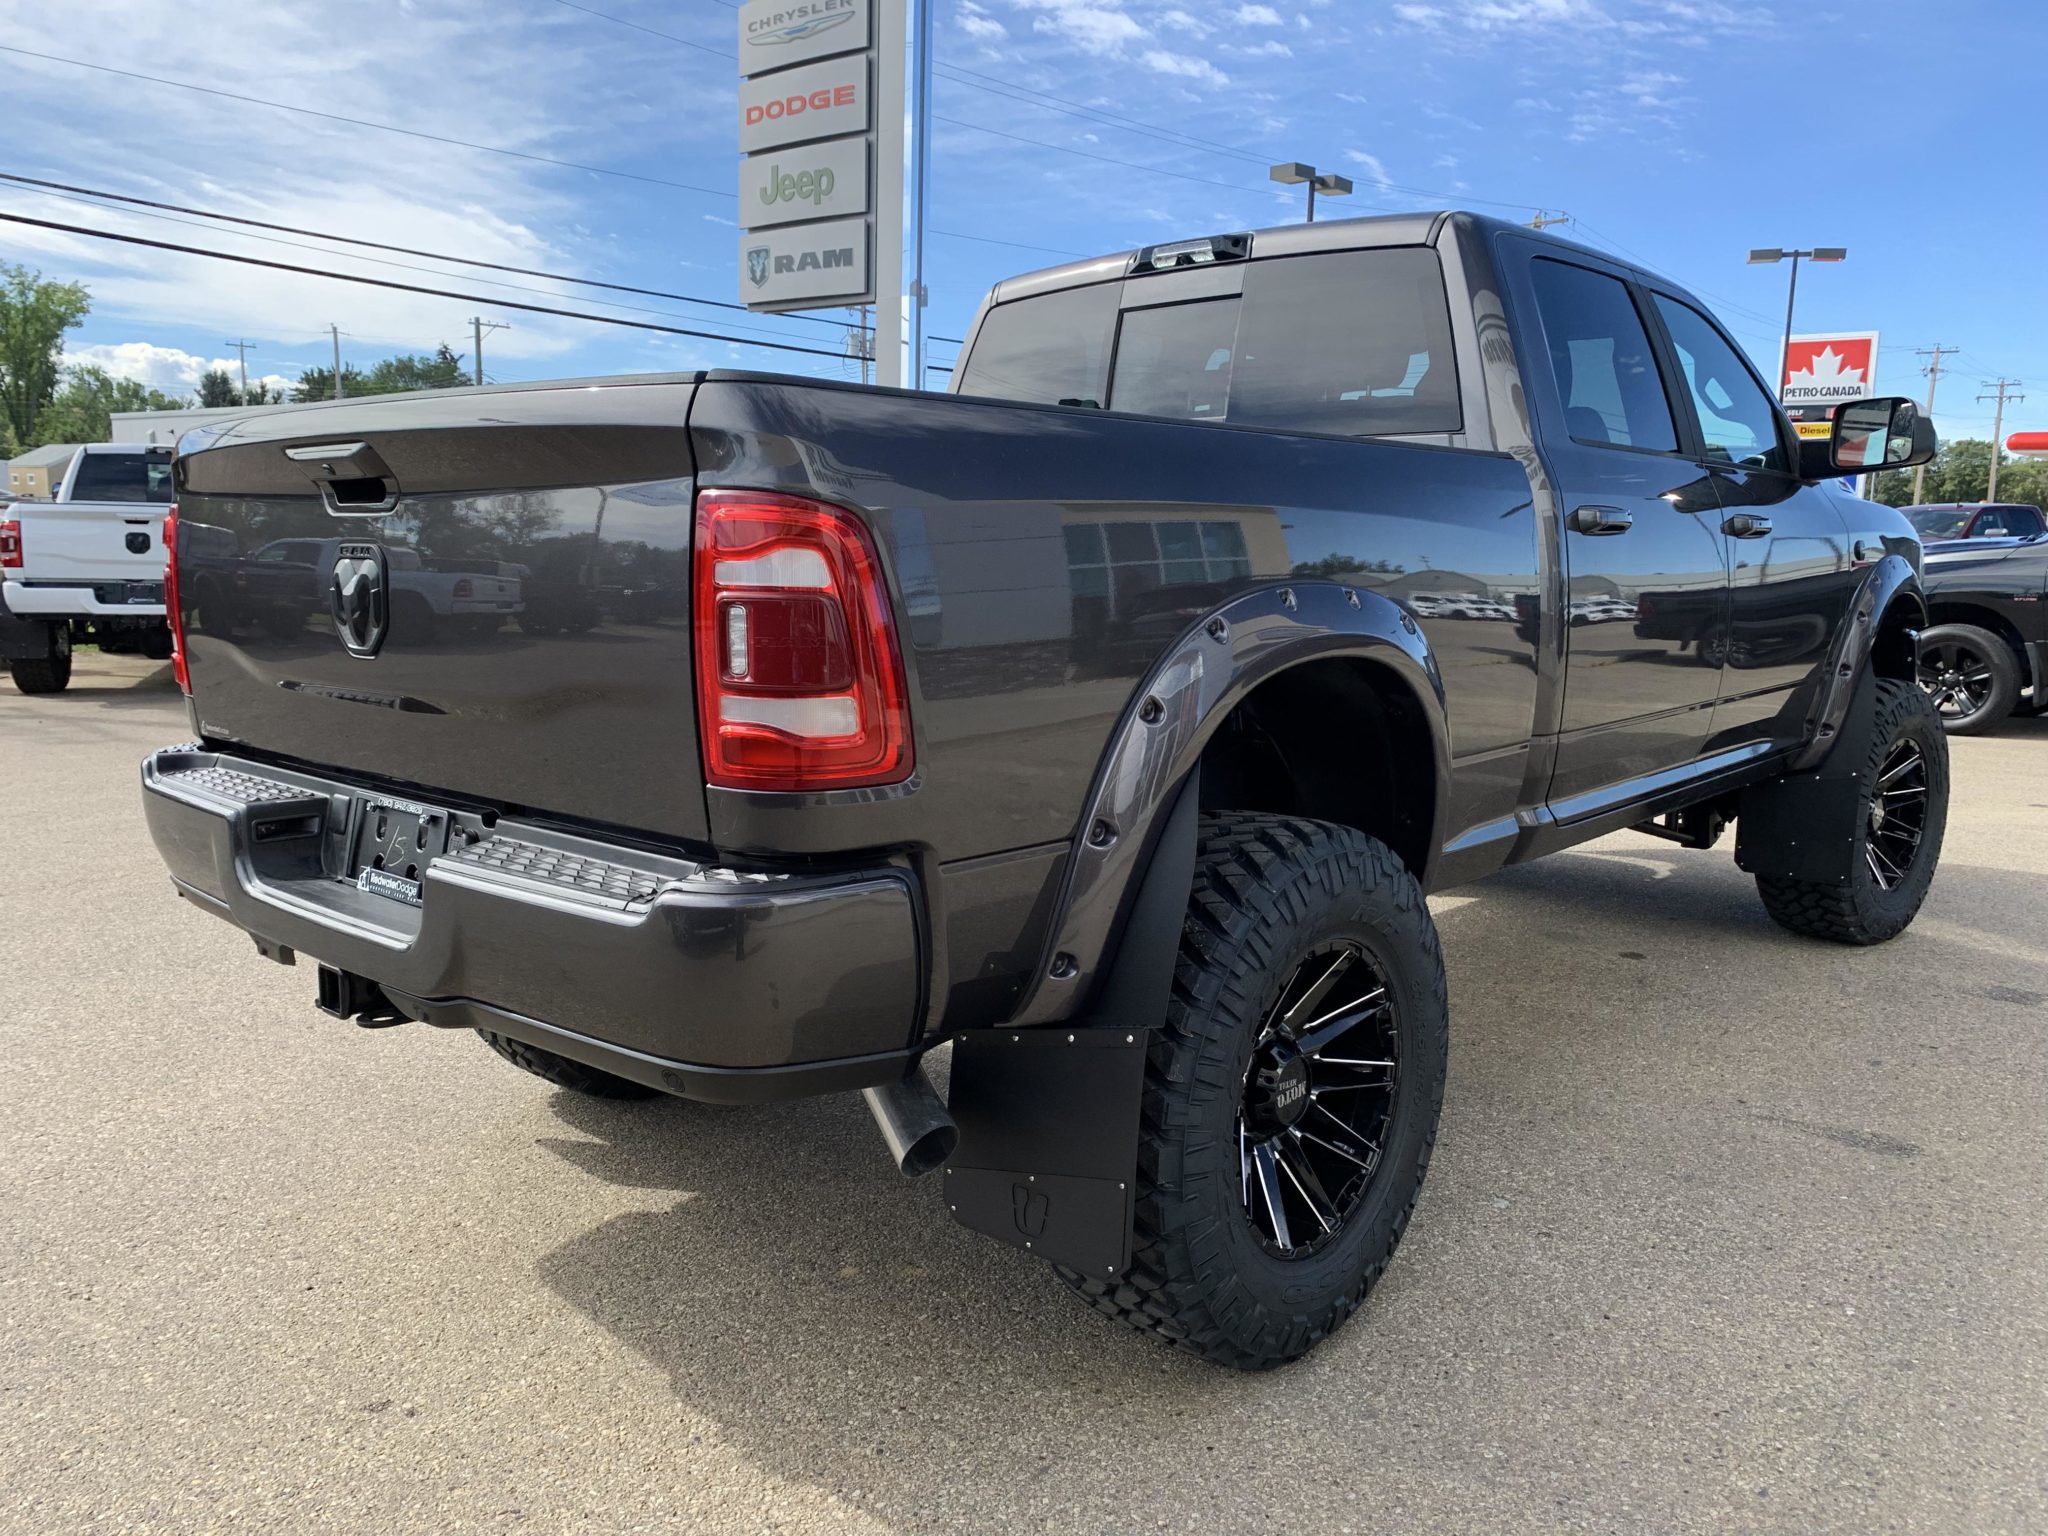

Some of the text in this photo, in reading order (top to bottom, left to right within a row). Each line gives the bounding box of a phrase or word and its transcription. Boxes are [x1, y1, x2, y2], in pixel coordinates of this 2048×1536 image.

[748, 0, 853, 33] CHRYSLER
[746, 85, 855, 125] DODGE
[760, 164, 835, 206] Jeep
[774, 248, 854, 274] RAM
[1800, 426, 1830, 434] Diesel
[340, 546, 370, 557] RAM
[1277, 1080, 1306, 1108] MOTO
